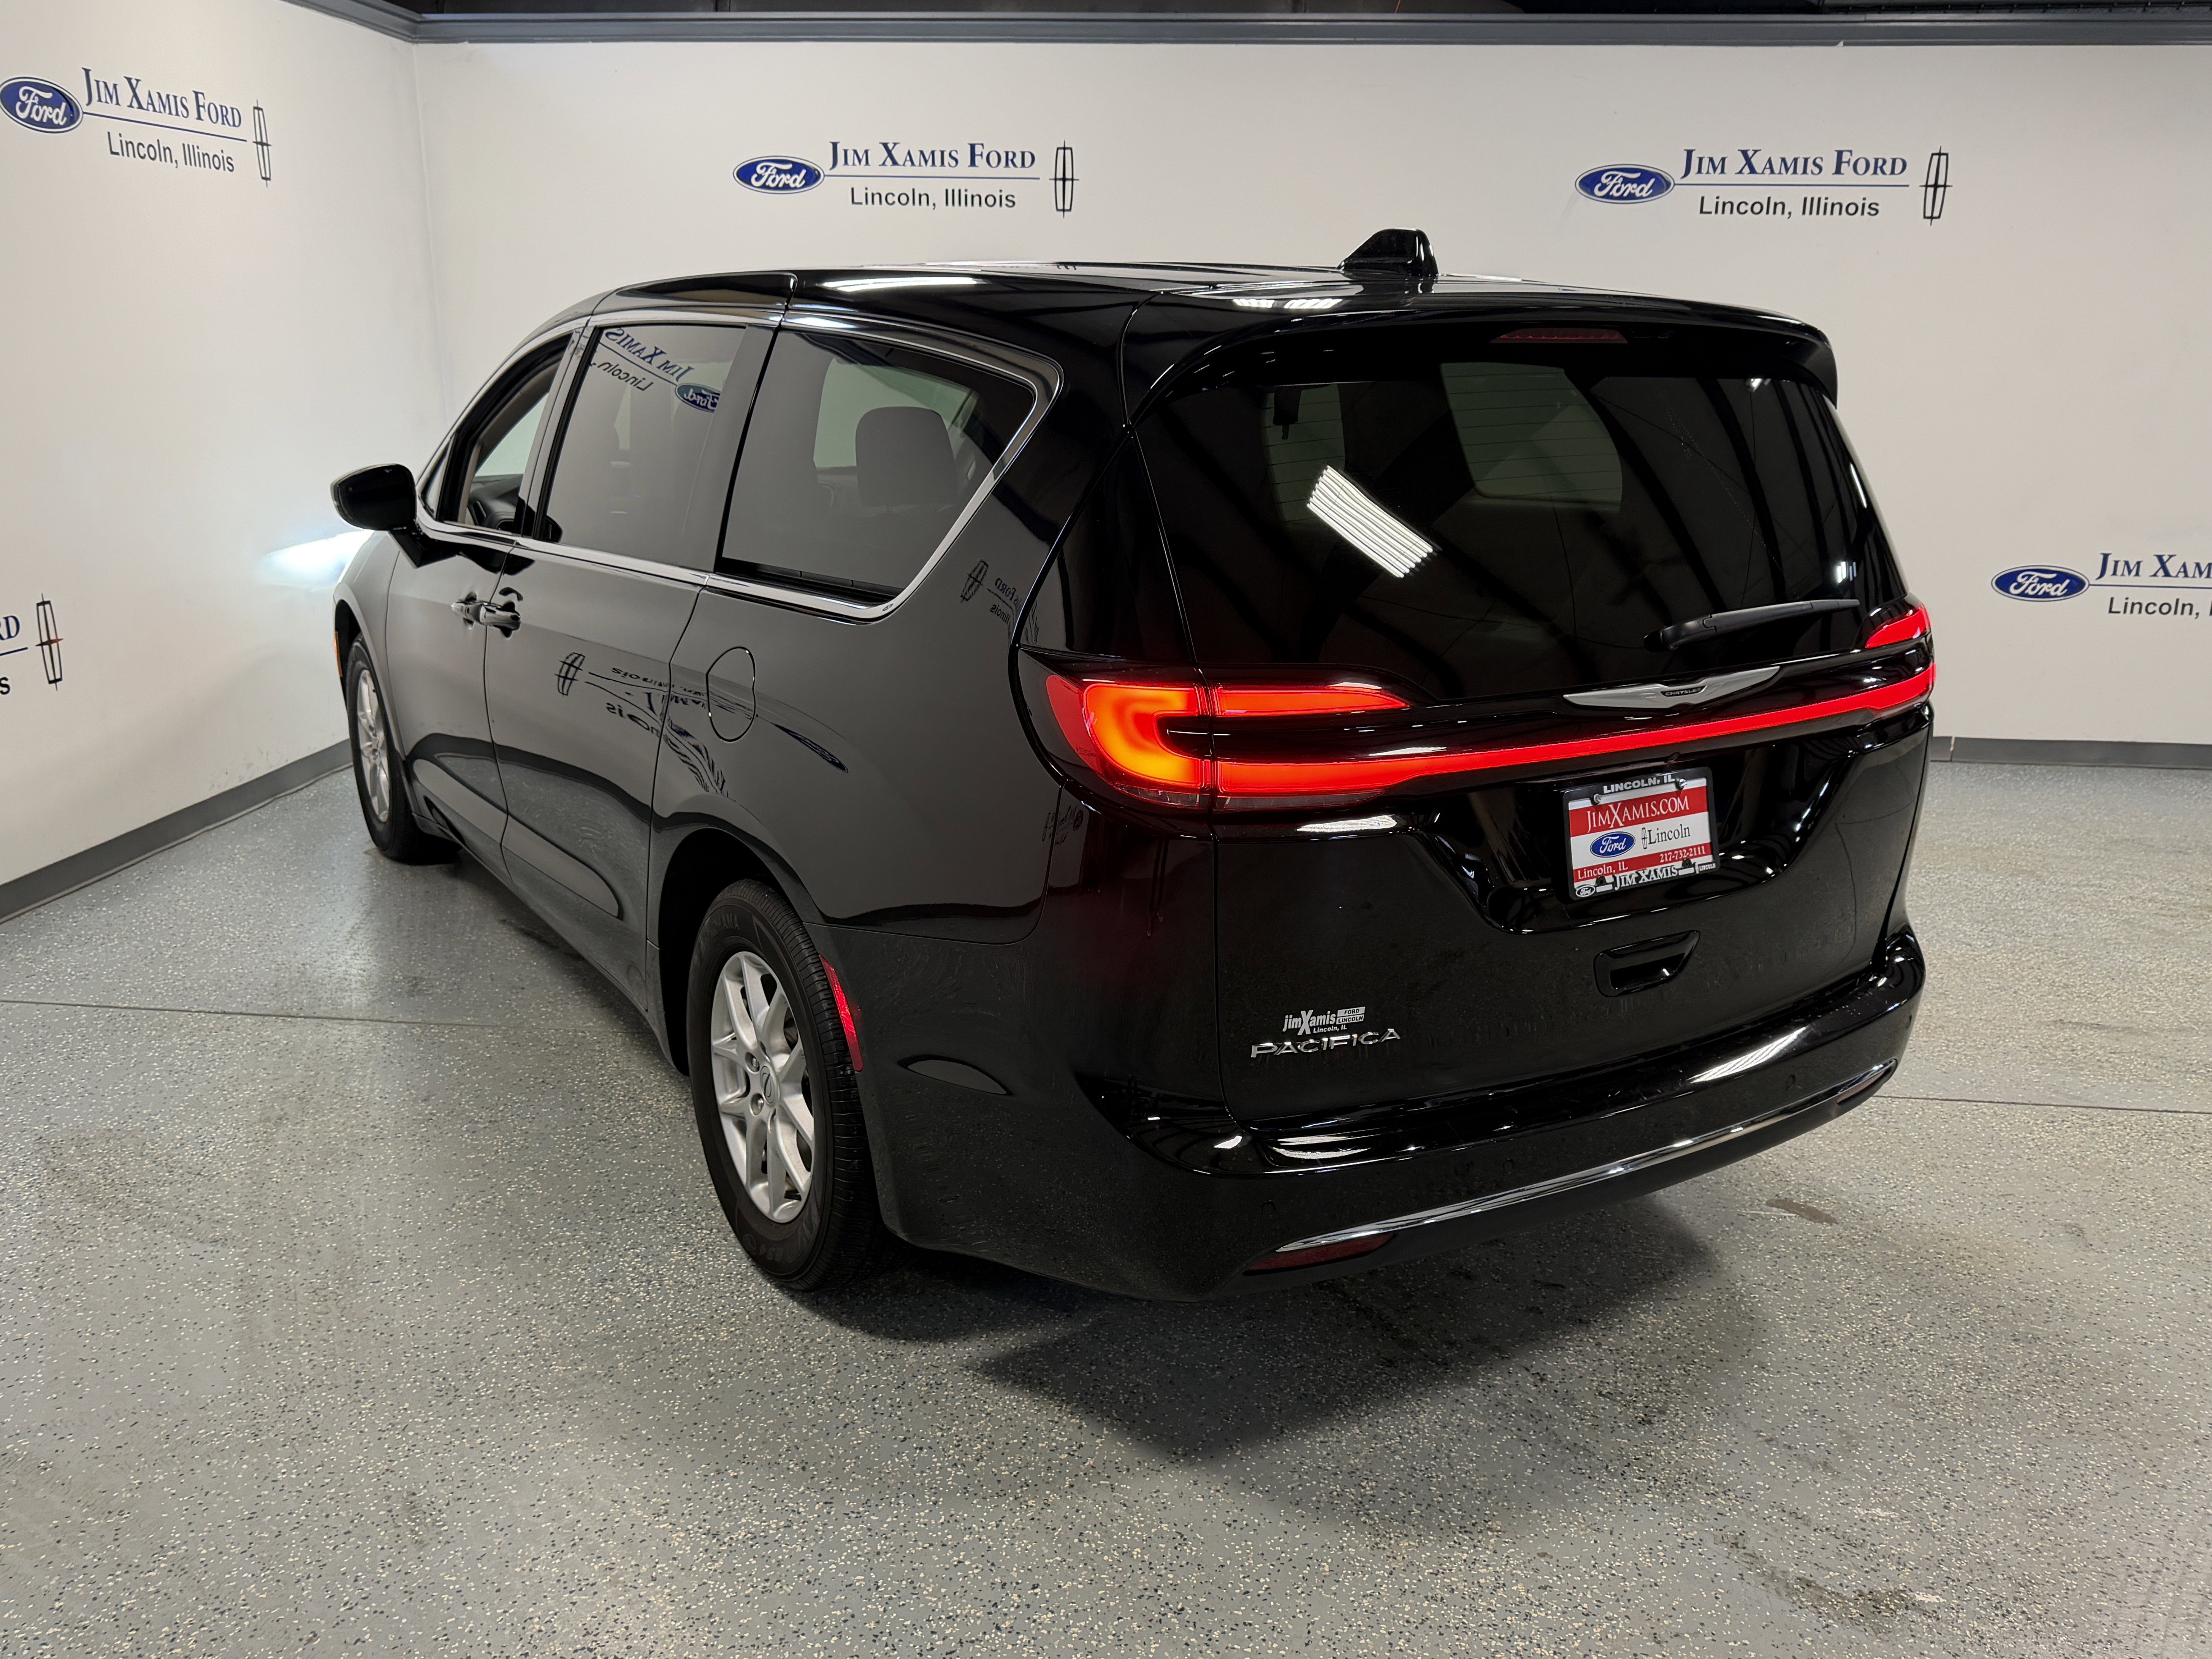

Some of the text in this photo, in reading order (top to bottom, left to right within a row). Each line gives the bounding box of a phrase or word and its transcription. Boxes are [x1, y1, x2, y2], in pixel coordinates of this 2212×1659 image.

[15, 85, 67, 126] Ford
[81, 67, 242, 127] JIM XAMIS FORD
[107, 131, 235, 172] Lincoln, Illinois
[829, 141, 1036, 170] JIM XAMIS FORD
[1680, 149, 1907, 179] JIM XAMIS FORD
[750, 162, 806, 188] Ford
[1594, 171, 1653, 198] Ford
[850, 187, 1015, 209] Lincoln, Illinois
[1699, 196, 1879, 218] Lincoln, Illinois
[2095, 553, 2143, 580] JIM
[2009, 571, 2068, 596] Ford
[2108, 597, 2200, 620] Lincoln,
[1604, 775, 1675, 793] LINCOLN, IL
[1600, 836, 1626, 854] Ford
[1647, 824, 1691, 845] Lincoln
[1659, 846, 1706, 863] 217-732-2111
[1578, 861, 1628, 879] Lincoln, IL
[1614, 866, 1678, 890] JIM XAMIS
[1250, 1028, 1401, 1058] PACIFICA
